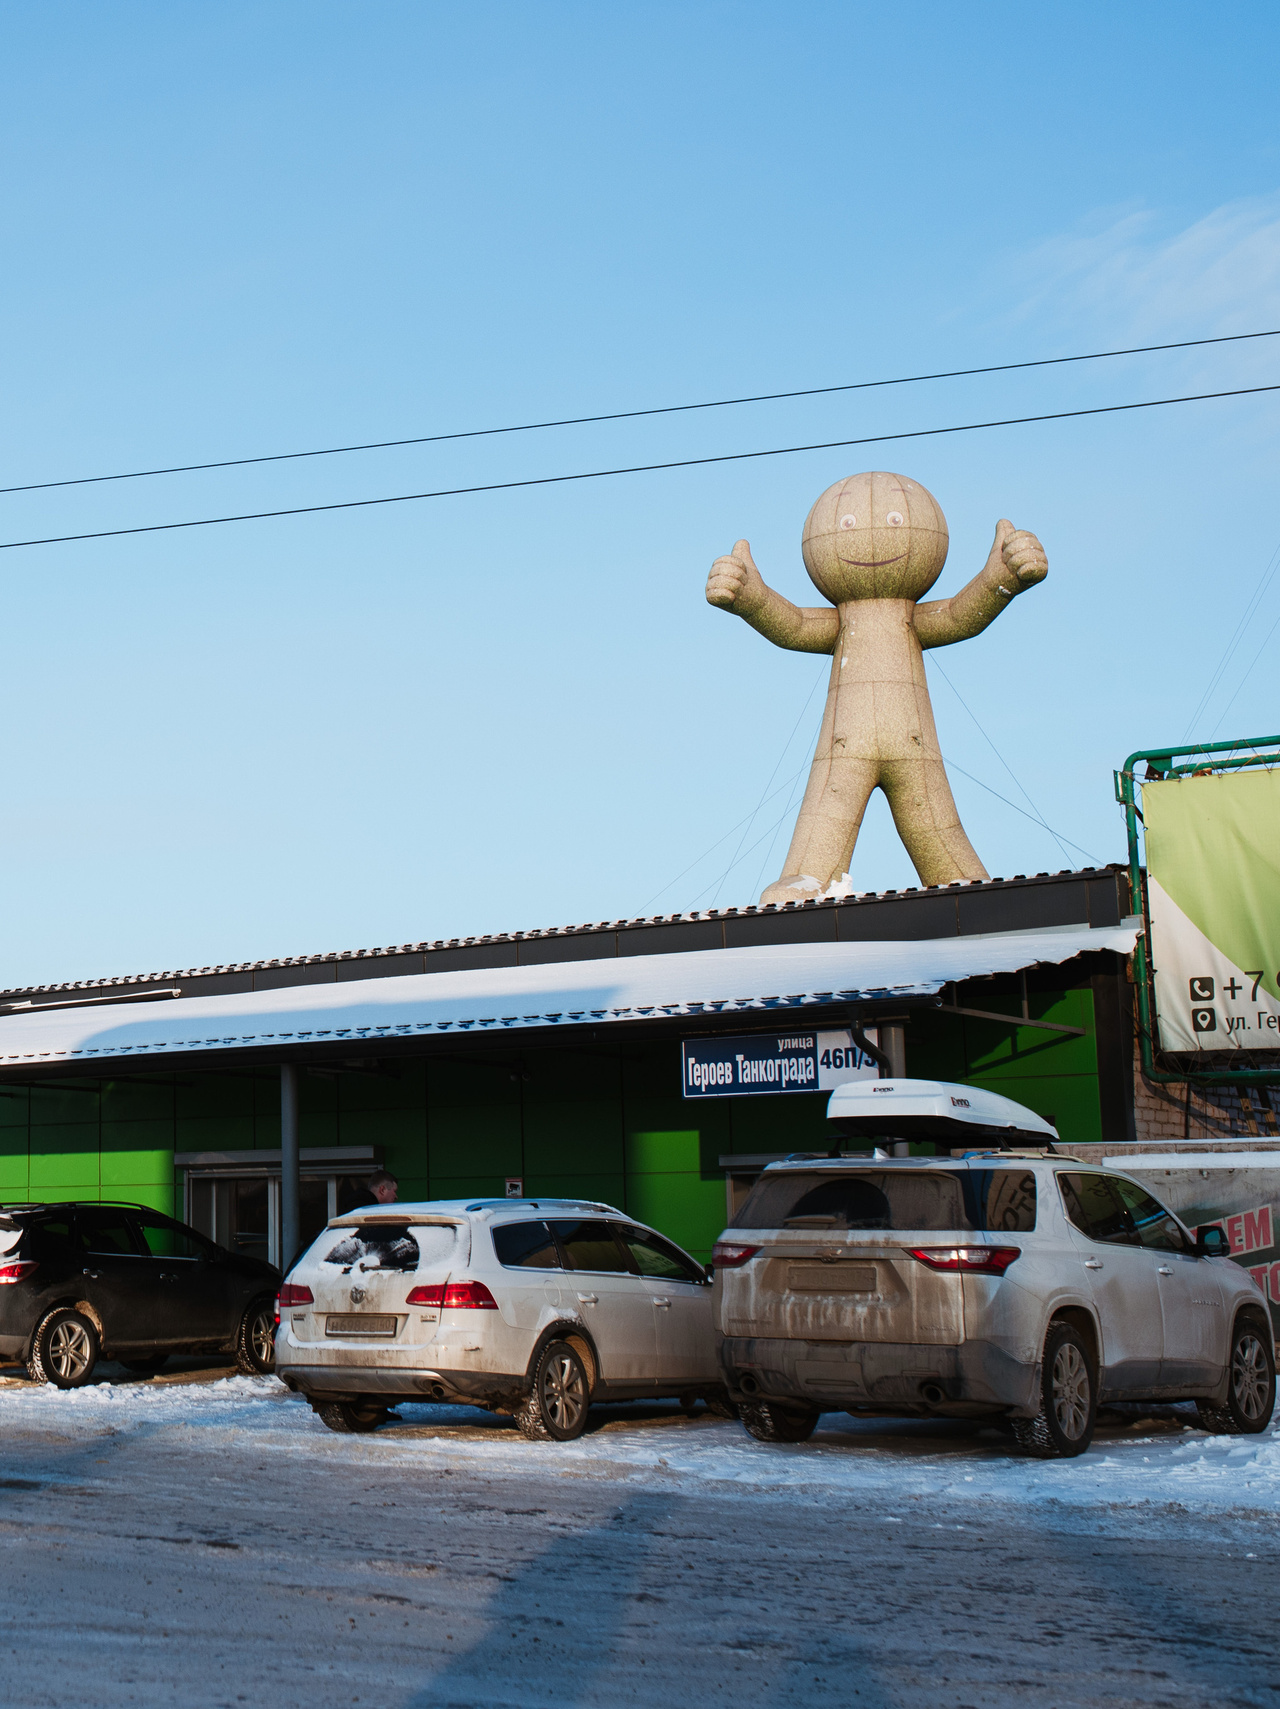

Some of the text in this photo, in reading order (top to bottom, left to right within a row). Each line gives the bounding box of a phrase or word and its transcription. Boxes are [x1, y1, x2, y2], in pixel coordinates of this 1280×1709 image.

[1223, 970, 1264, 1002] +7
[1225, 1016, 1251, 1035] ул.
[777, 1037, 814, 1053] улица
[688, 1054, 815, 1092] Героев Танкограда
